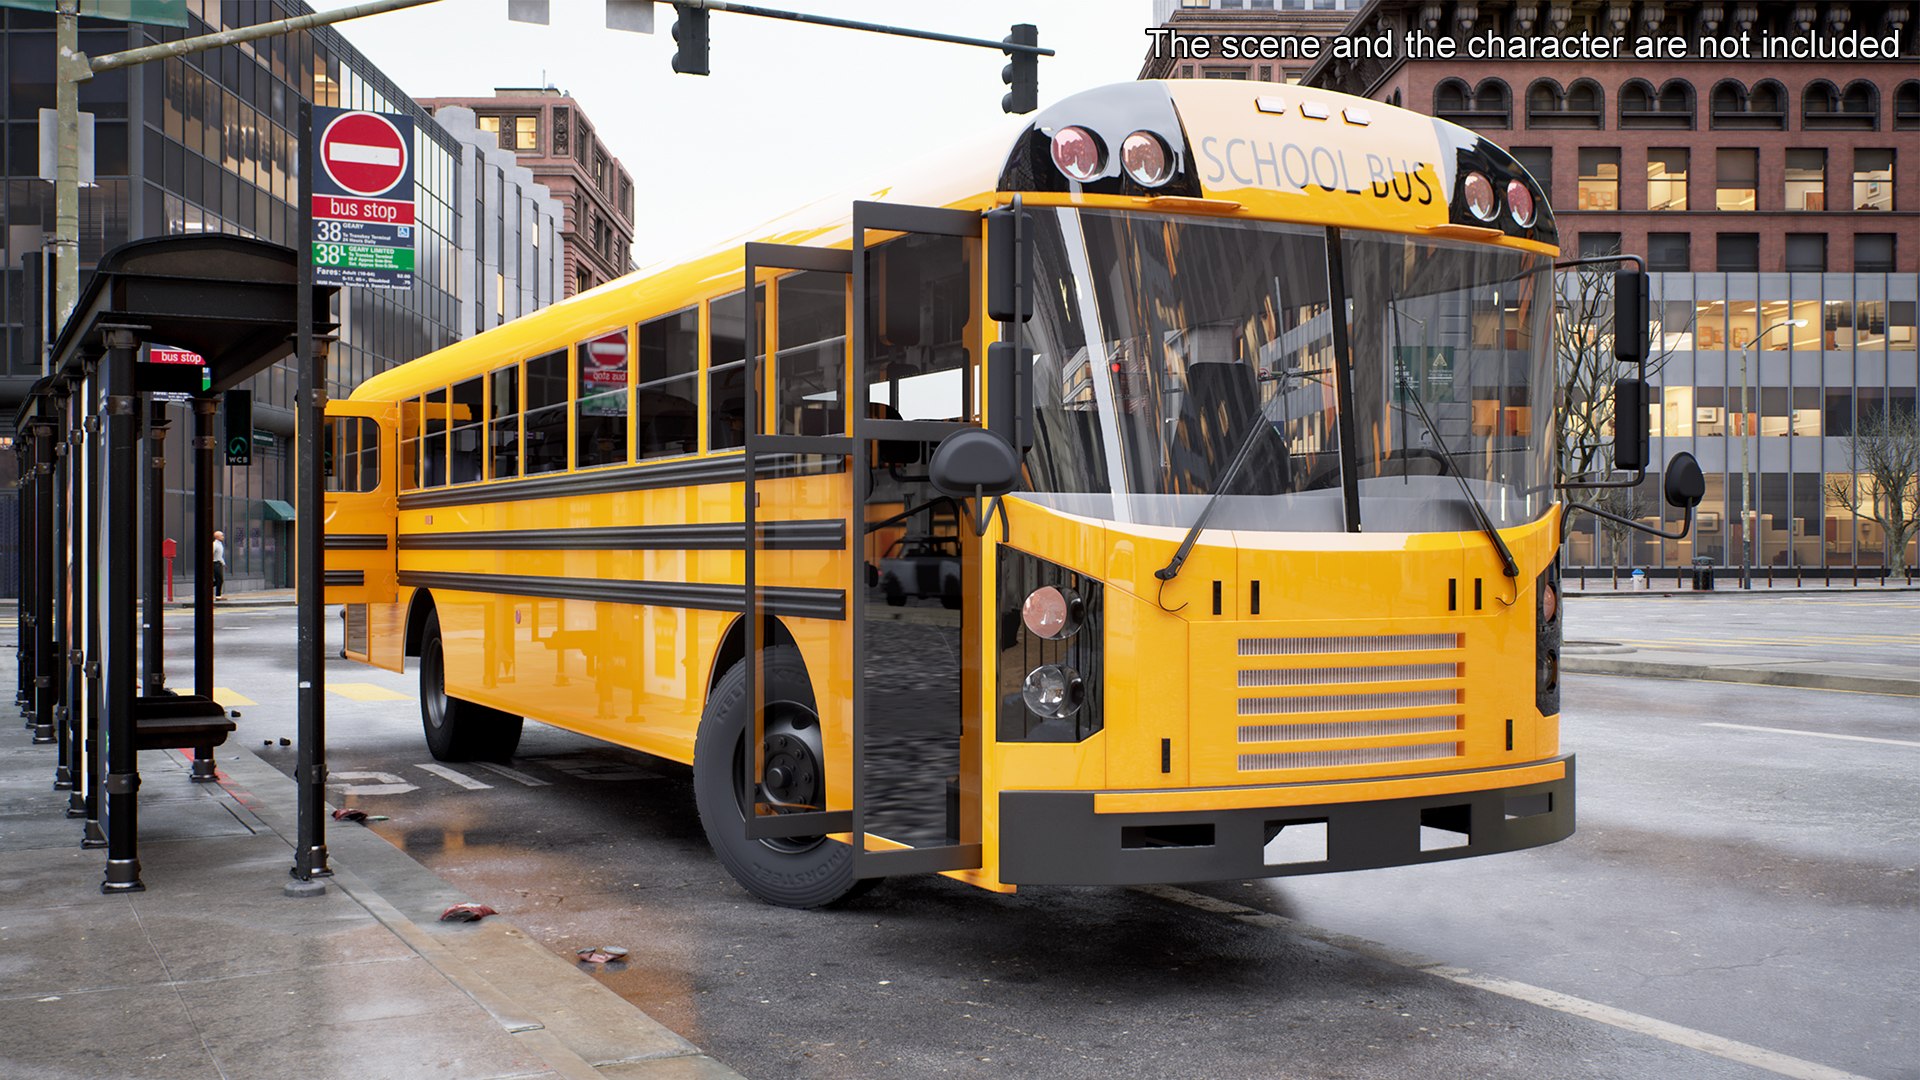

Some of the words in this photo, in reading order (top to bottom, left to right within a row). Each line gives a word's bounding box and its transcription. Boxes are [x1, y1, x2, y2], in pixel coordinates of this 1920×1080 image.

[1201, 135, 1361, 196] SCHOOL
[1365, 152, 1433, 206] BUS
[330, 197, 358, 217] bus
[363, 202, 397, 222] stop
[317, 221, 342, 242] 38
[316, 267, 341, 276] Fares:
[161, 352, 178, 362] bus
[180, 353, 201, 364] stop
